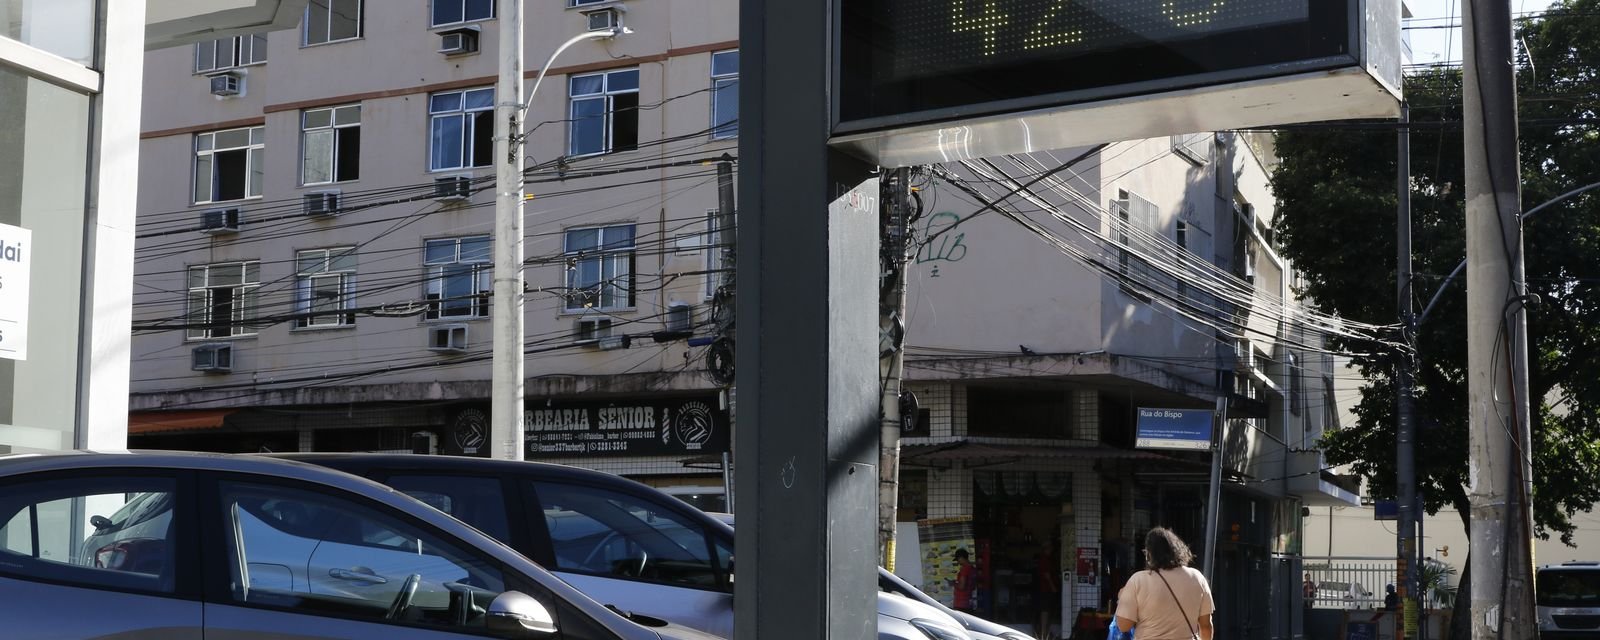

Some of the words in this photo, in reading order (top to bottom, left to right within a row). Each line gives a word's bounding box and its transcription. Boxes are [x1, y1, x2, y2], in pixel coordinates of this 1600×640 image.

[524, 409, 590, 432] RBEARIA
[598, 403, 656, 430] SÊNIOR
[1164, 411, 1183, 419] Bispo
